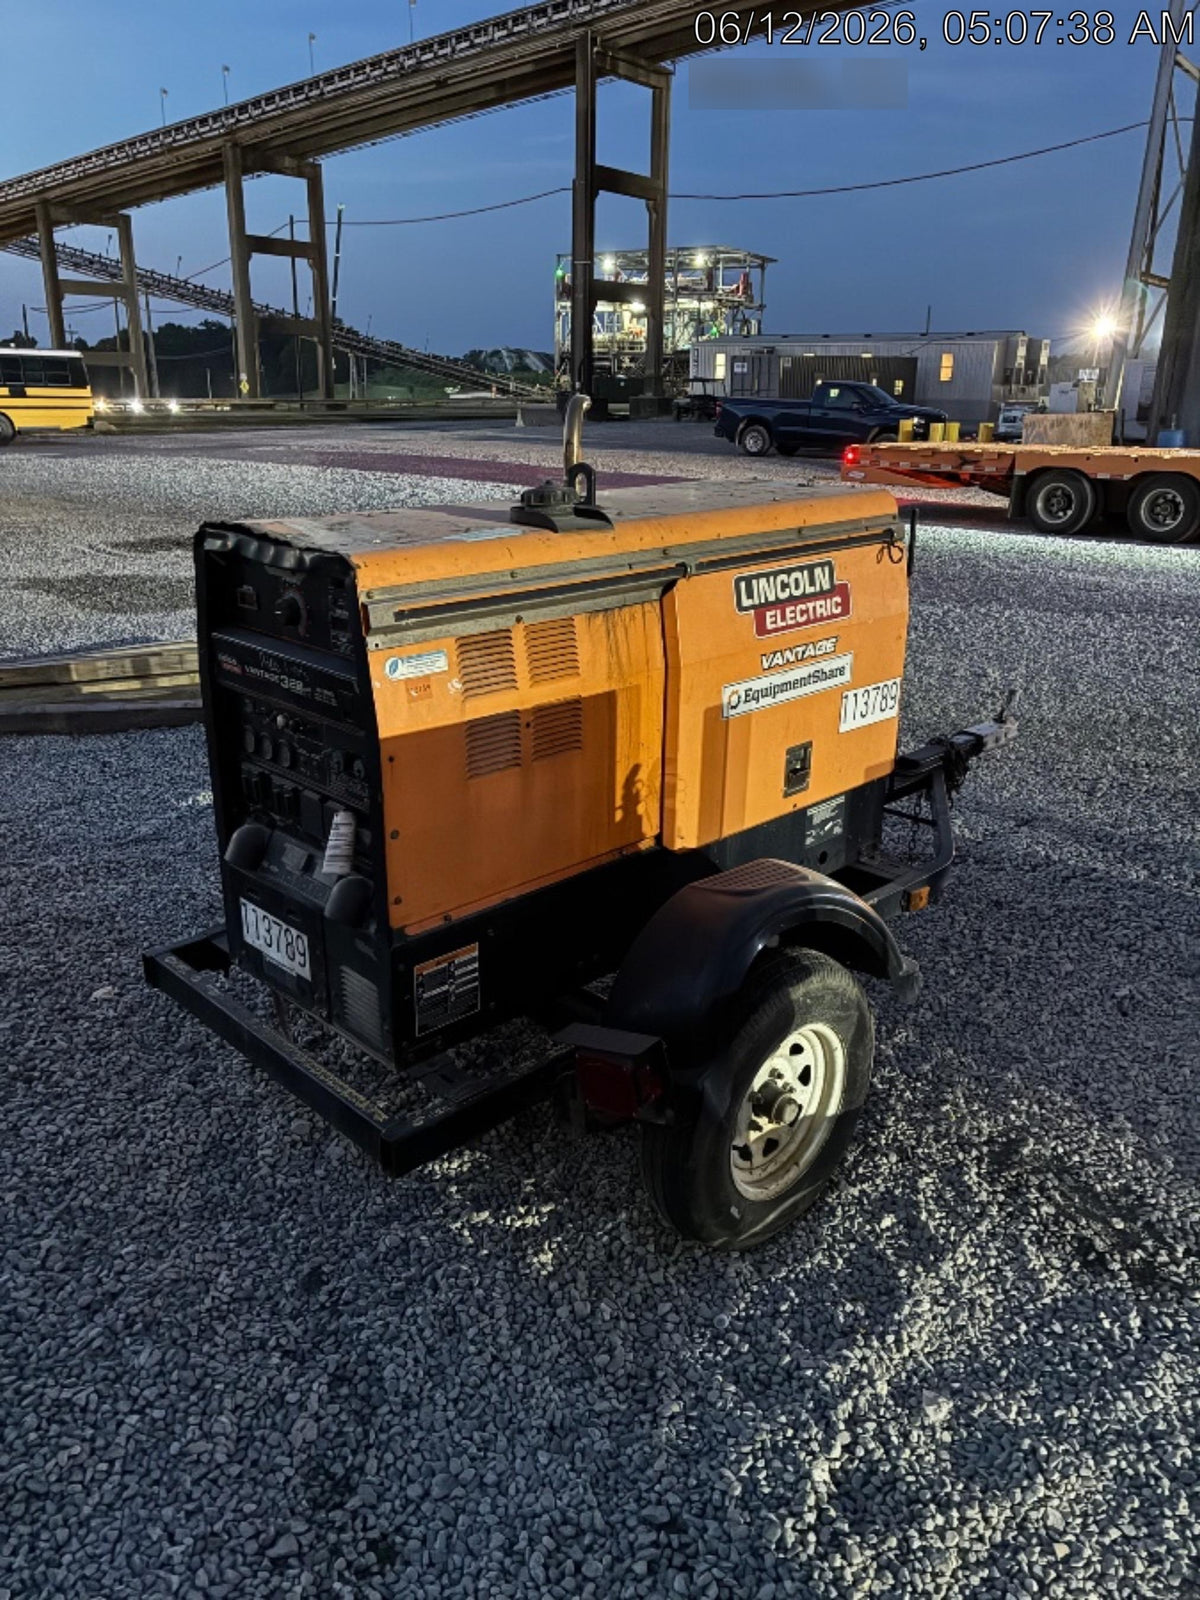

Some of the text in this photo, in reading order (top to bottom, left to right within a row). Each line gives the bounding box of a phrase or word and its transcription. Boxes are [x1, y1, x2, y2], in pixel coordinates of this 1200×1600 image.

[739, 565, 830, 608] LINCOLN
[764, 596, 843, 630] ELECTRIC
[760, 636, 839, 671] VANTAGE
[743, 664, 846, 705] EquipmentShare
[842, 681, 900, 724] 113789
[241, 902, 307, 968] 113789
